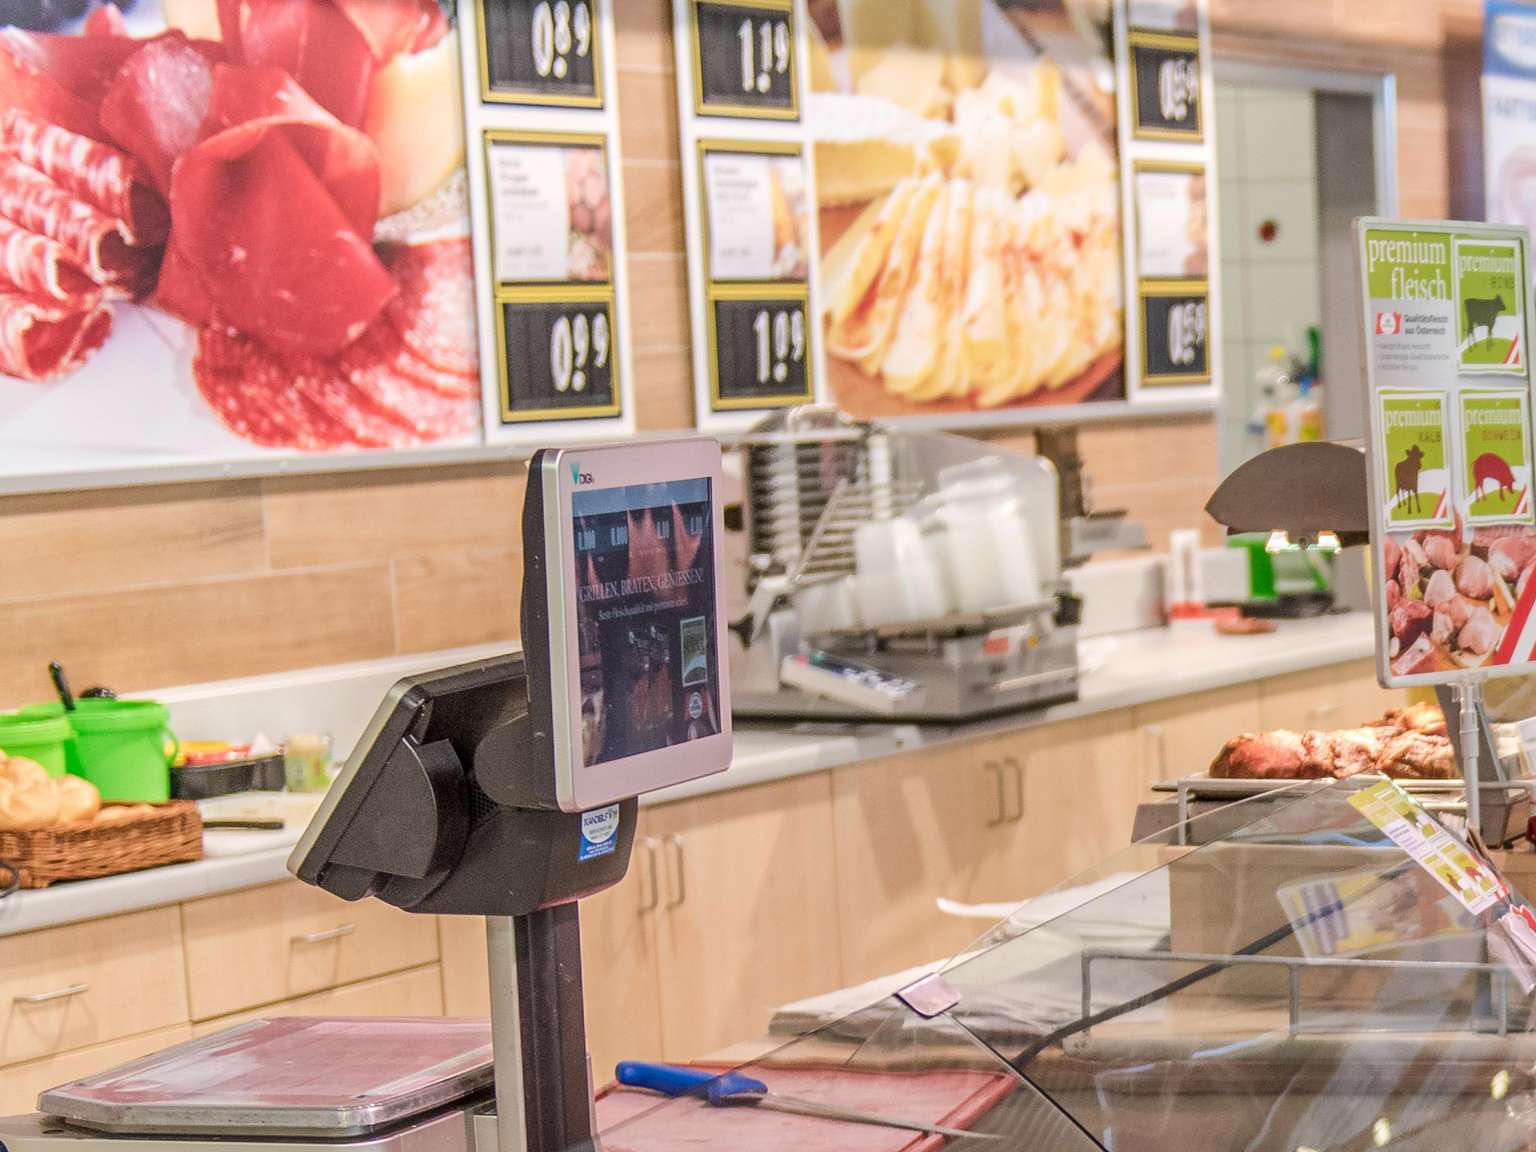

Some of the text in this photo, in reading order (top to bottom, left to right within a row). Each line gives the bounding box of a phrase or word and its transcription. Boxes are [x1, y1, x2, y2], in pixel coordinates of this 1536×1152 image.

[1368, 231, 1447, 273] premium
[1459, 248, 1516, 278] premium
[1390, 267, 1448, 301] fleisch
[1385, 402, 1442, 434] premium
[1465, 401, 1521, 433] premium
